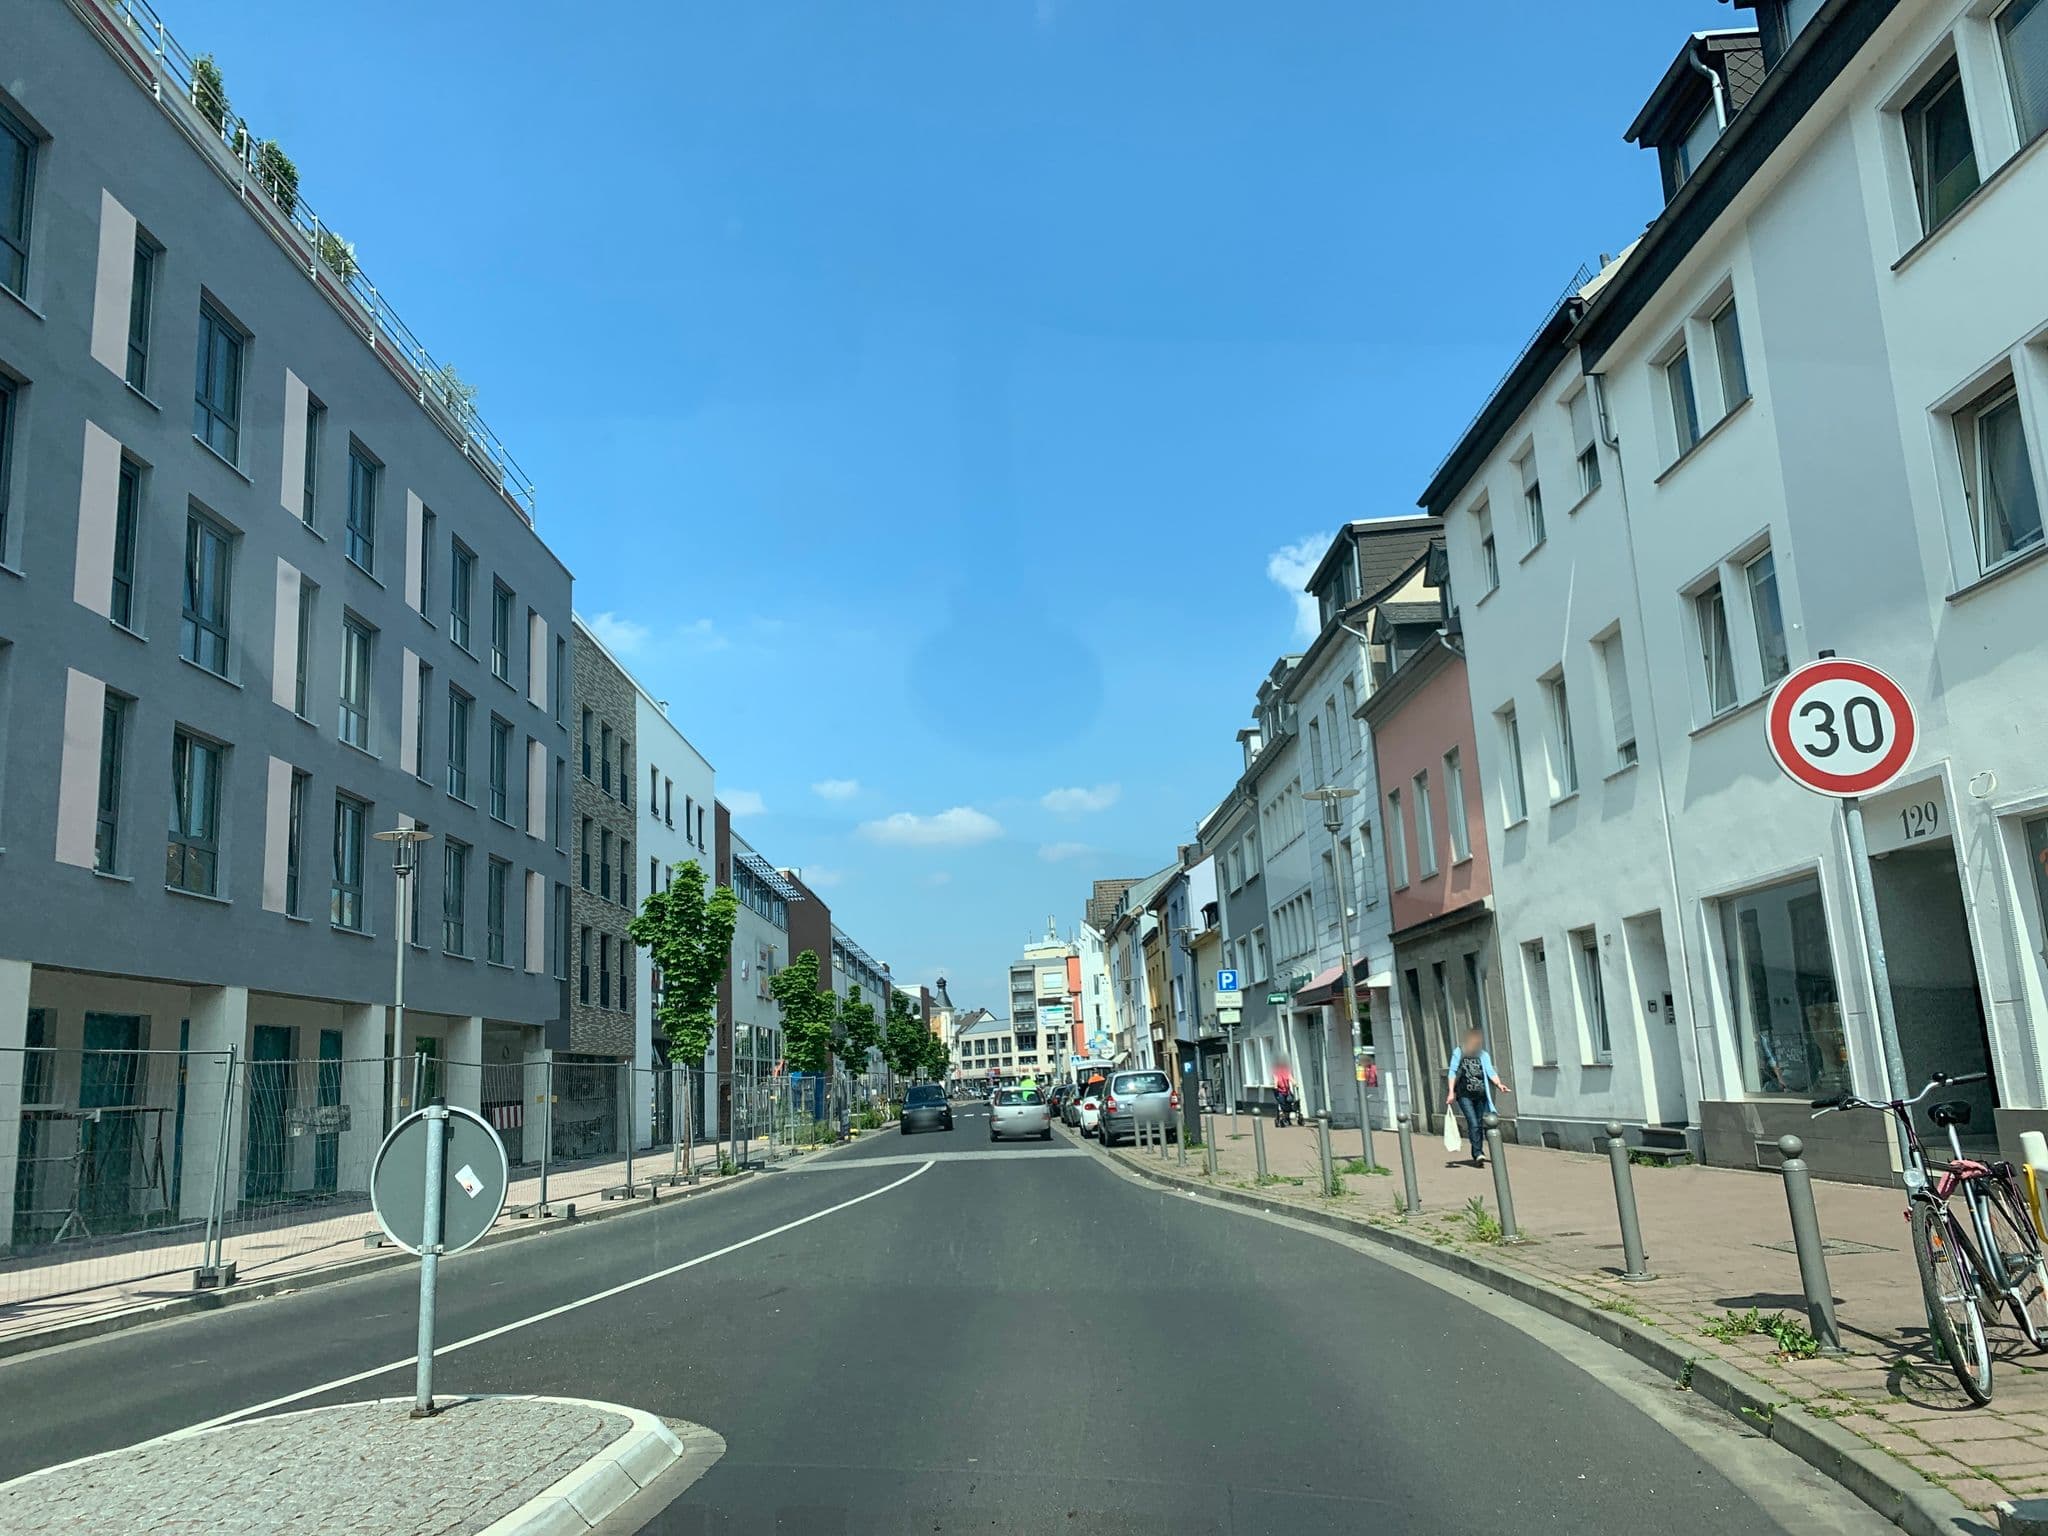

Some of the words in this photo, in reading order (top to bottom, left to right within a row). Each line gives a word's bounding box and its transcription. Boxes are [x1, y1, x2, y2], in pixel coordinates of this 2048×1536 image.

[1800, 697, 1883, 757] 30
[1899, 801, 1938, 840] 129
[1221, 972, 1234, 989] P
